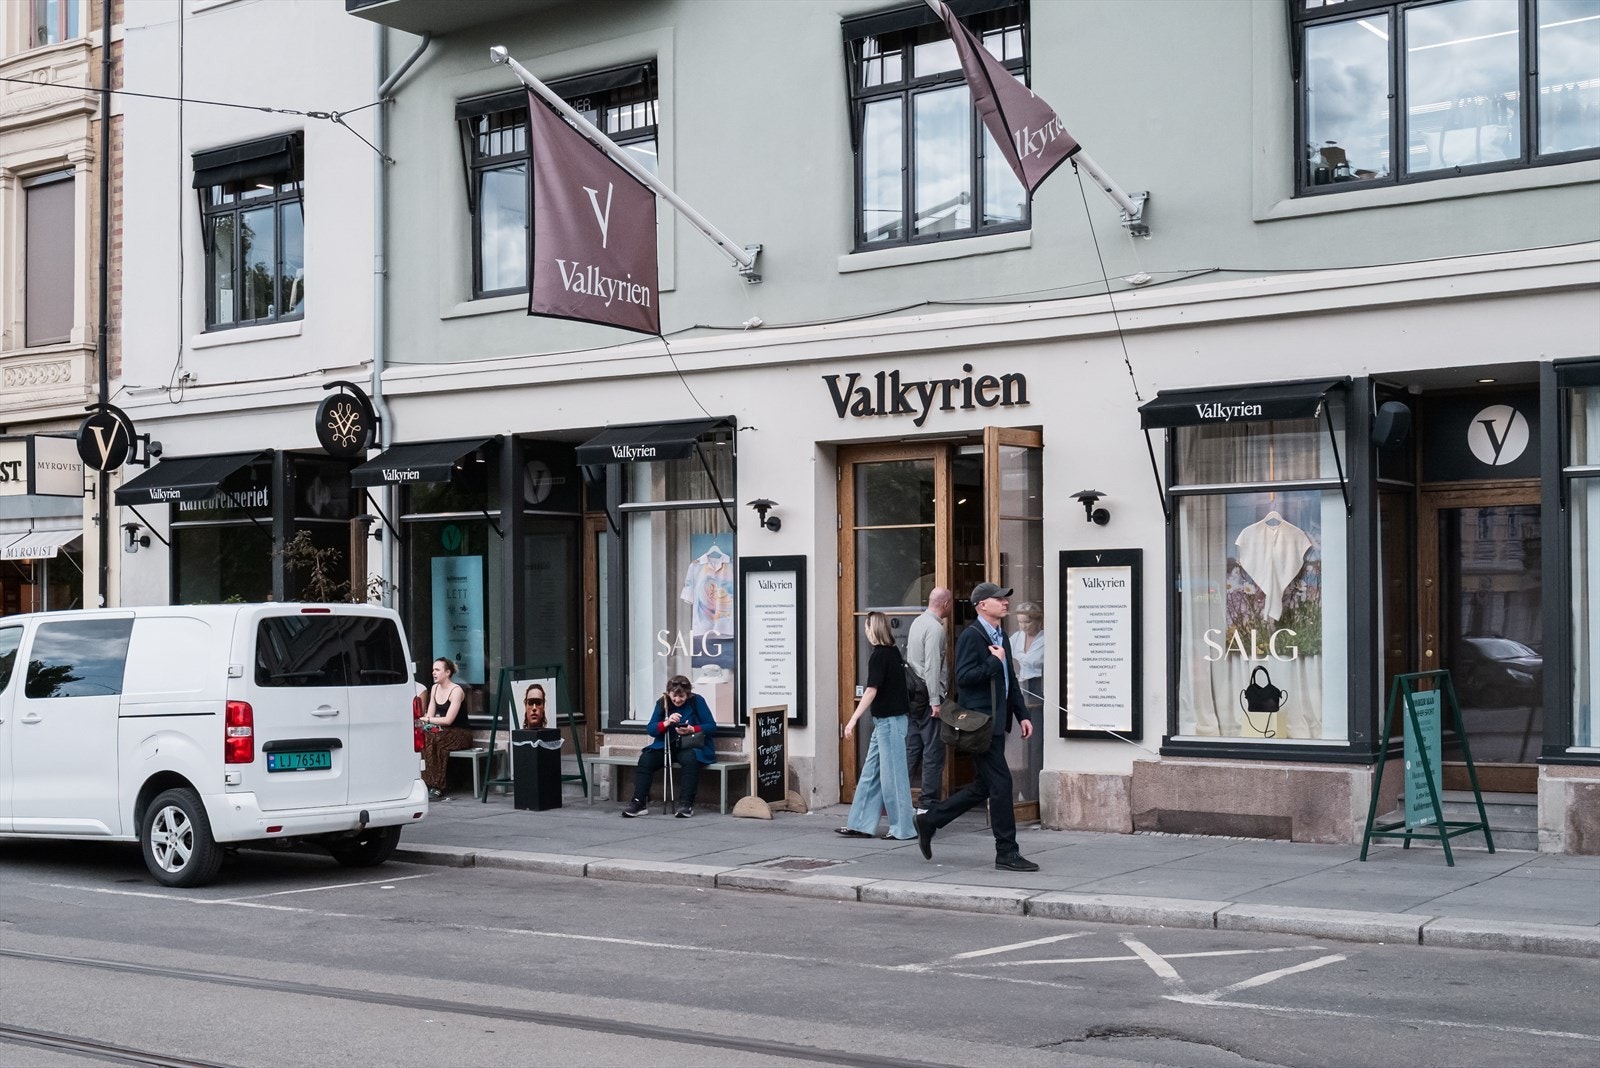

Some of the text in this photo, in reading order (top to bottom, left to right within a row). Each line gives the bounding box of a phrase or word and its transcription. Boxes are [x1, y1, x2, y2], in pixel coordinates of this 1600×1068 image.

[555, 258, 651, 308] Valkyrien
[821, 363, 1030, 428] Valkyrien
[1194, 401, 1263, 422] Valkyrien
[611, 445, 656, 461] Valkyrien
[37, 461, 82, 472] MYRQVIST
[382, 468, 420, 484] Valkyrien
[149, 487, 181, 502] Valkyrien
[5, 545, 53, 558] MYRQVIST
[758, 580, 793, 592] Valkyrien
[1082, 577, 1125, 591] Valkyrien
[446, 588, 468, 599] LETT
[657, 629, 722, 657] SALG
[1203, 628, 1298, 661] SALG
[766, 716, 780, 725] har
[280, 753, 326, 767] LJ 76541
